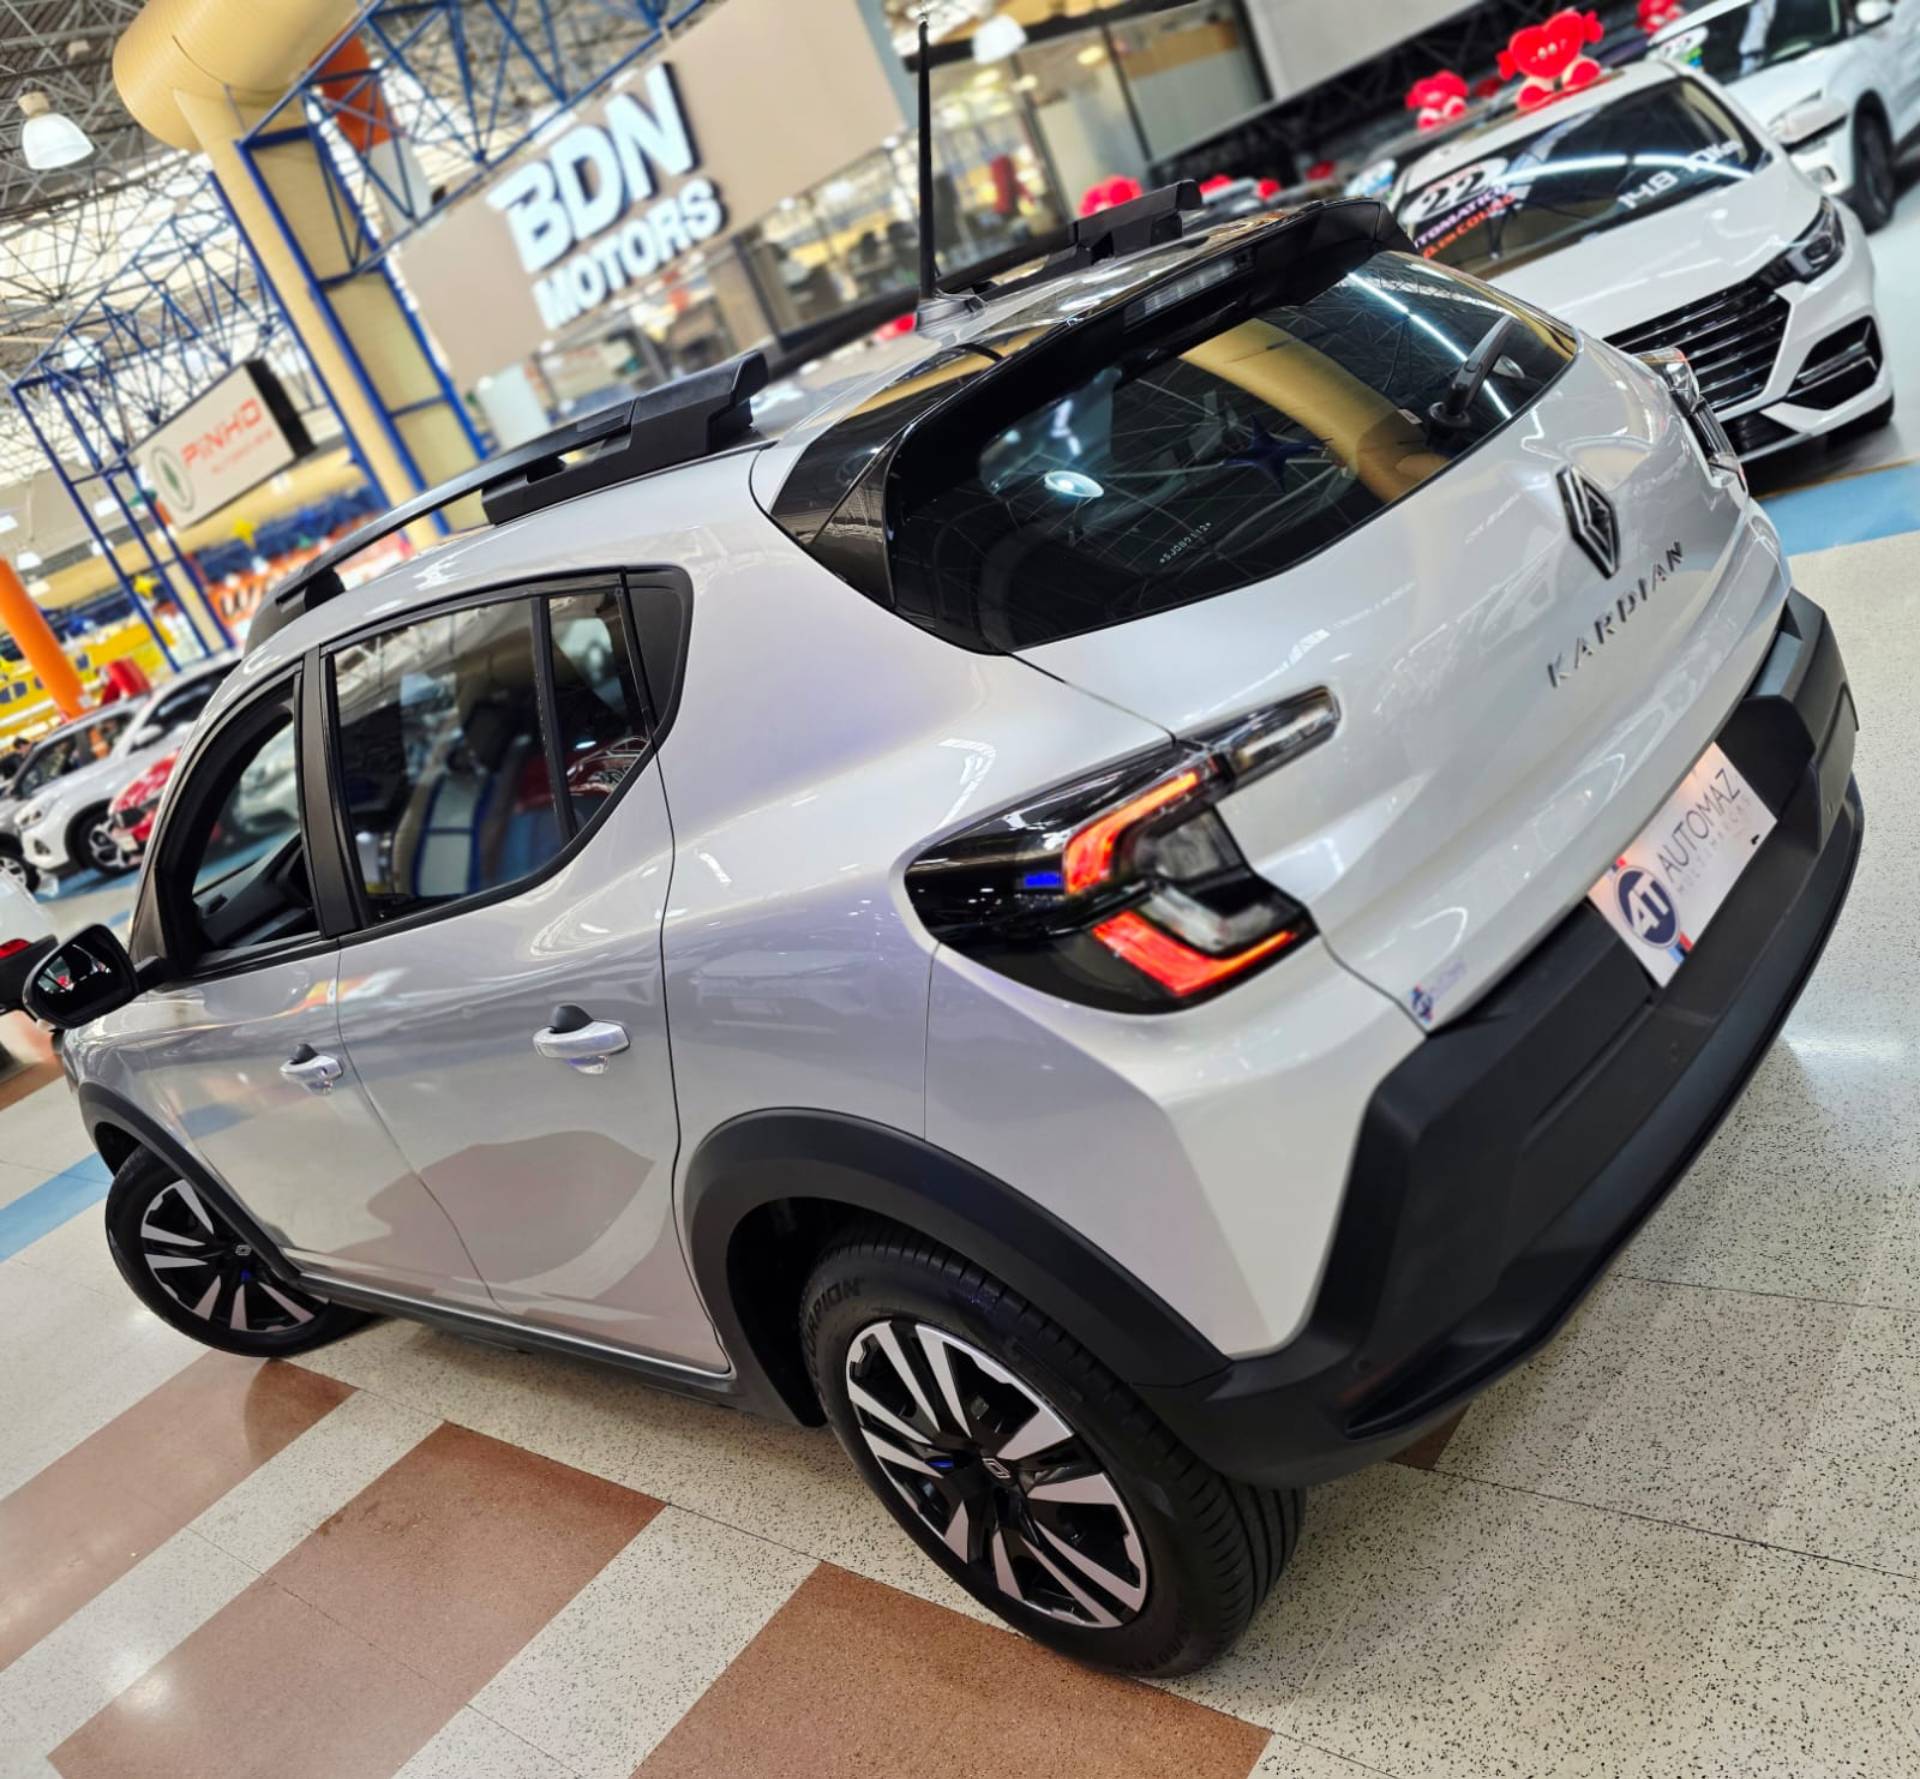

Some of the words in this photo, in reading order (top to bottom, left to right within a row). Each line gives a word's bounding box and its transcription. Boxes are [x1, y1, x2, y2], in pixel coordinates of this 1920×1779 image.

[485, 61, 697, 274] BDN
[1422, 170, 1486, 217] 22
[532, 177, 724, 331] MOTORS
[181, 398, 262, 467] PINHO
[1547, 541, 1684, 688] KARDIAN
[1657, 768, 1741, 883] AUTOMAZ
